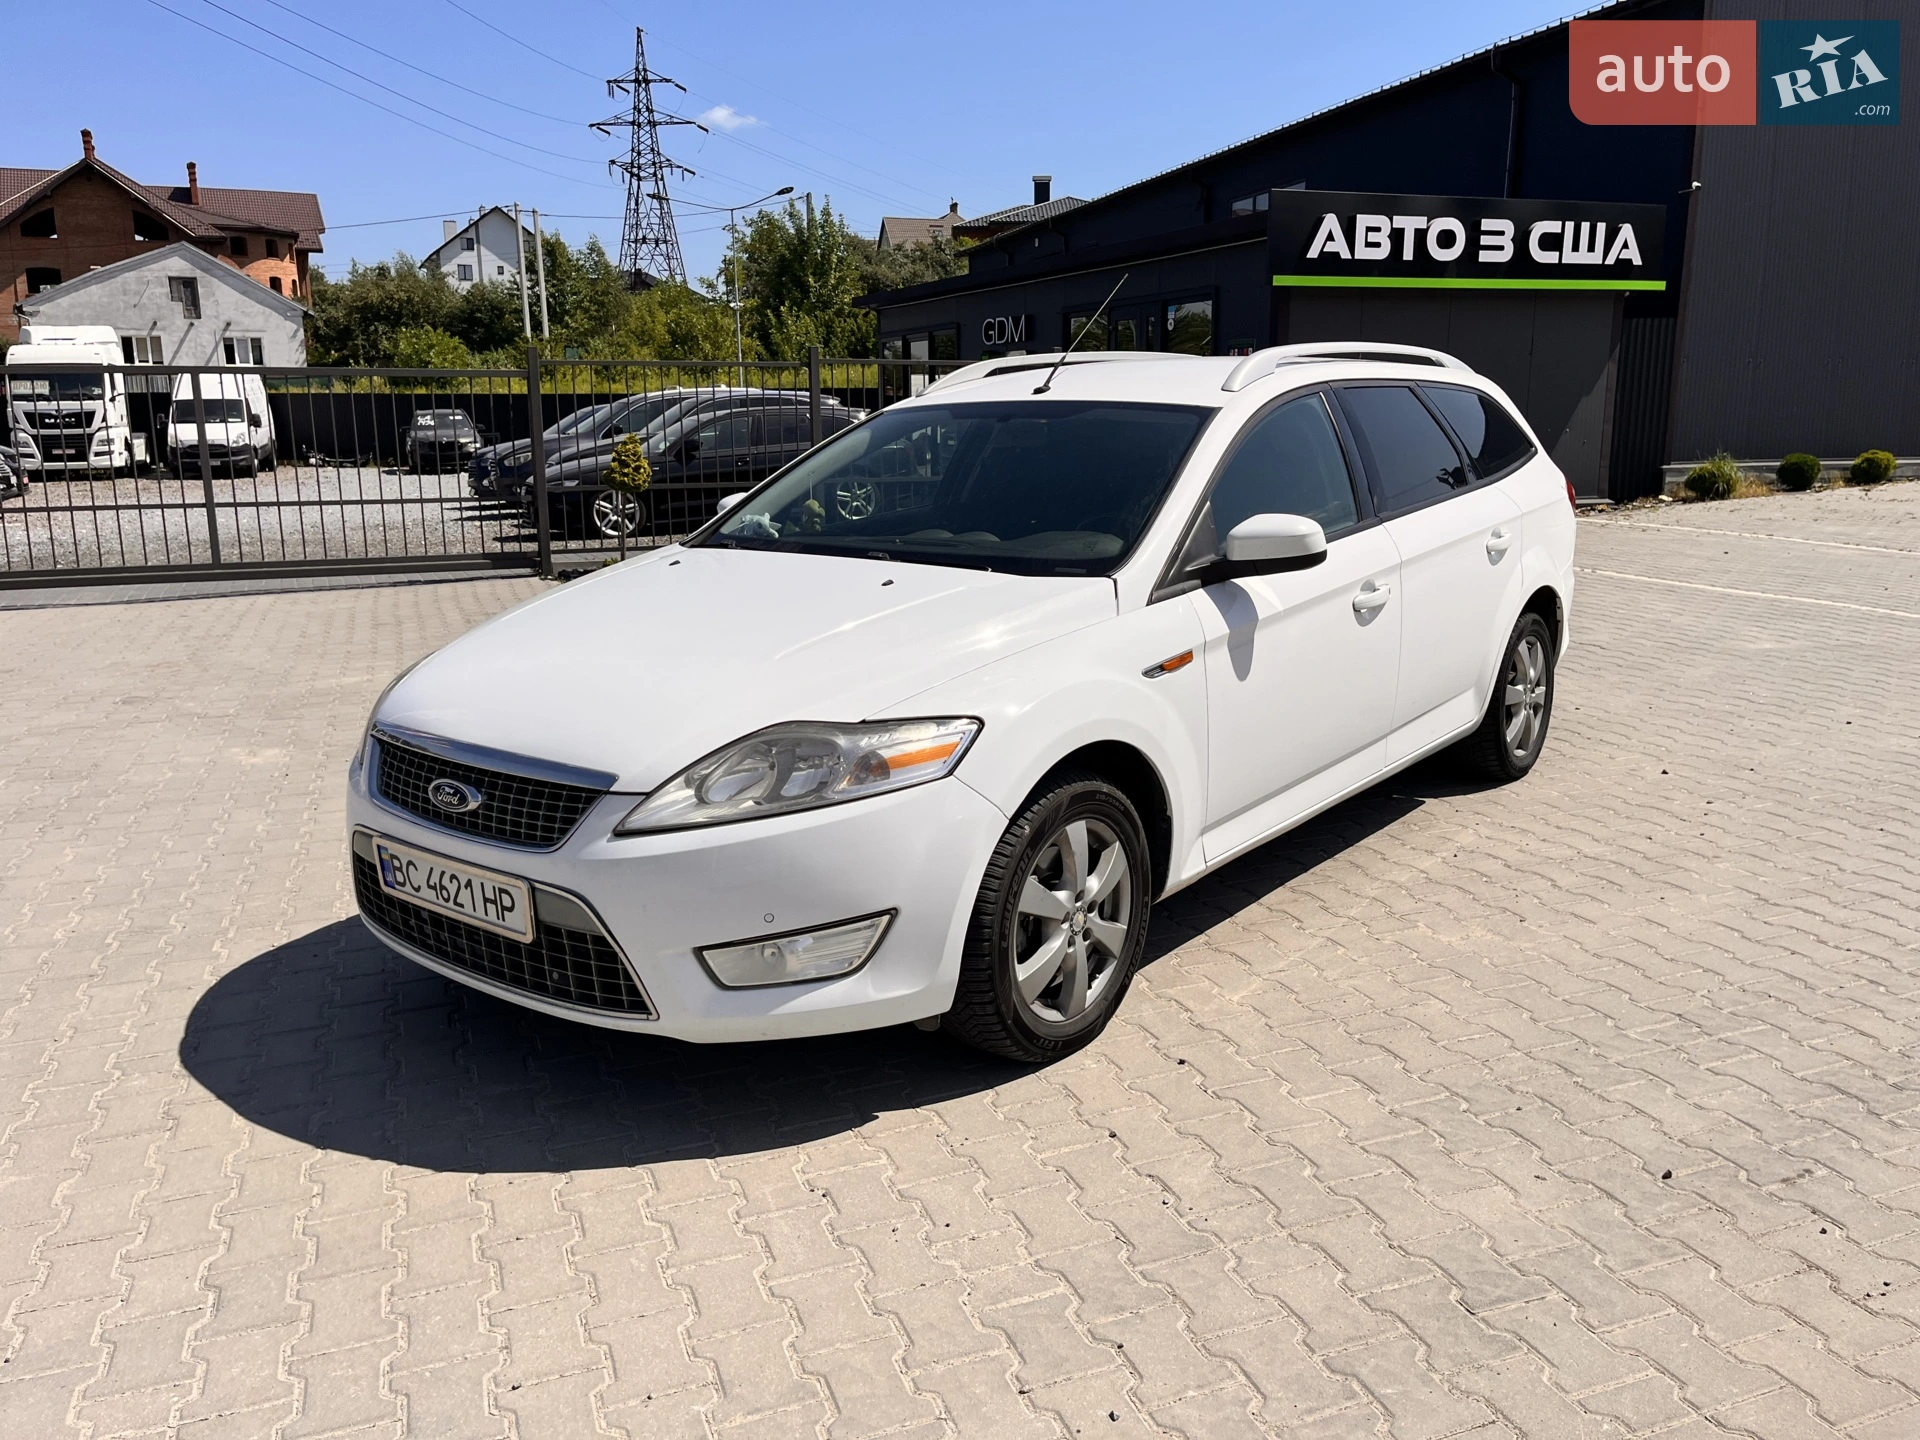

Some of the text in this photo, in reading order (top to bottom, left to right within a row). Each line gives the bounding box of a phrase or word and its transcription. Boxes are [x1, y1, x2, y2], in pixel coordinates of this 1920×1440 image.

[1306, 213, 1466, 261] АВТО
[1528, 220, 1643, 265] США
[982, 314, 1025, 345] GDM
[437, 785, 460, 805] Ford
[389, 853, 515, 922] BC 4621 HP
